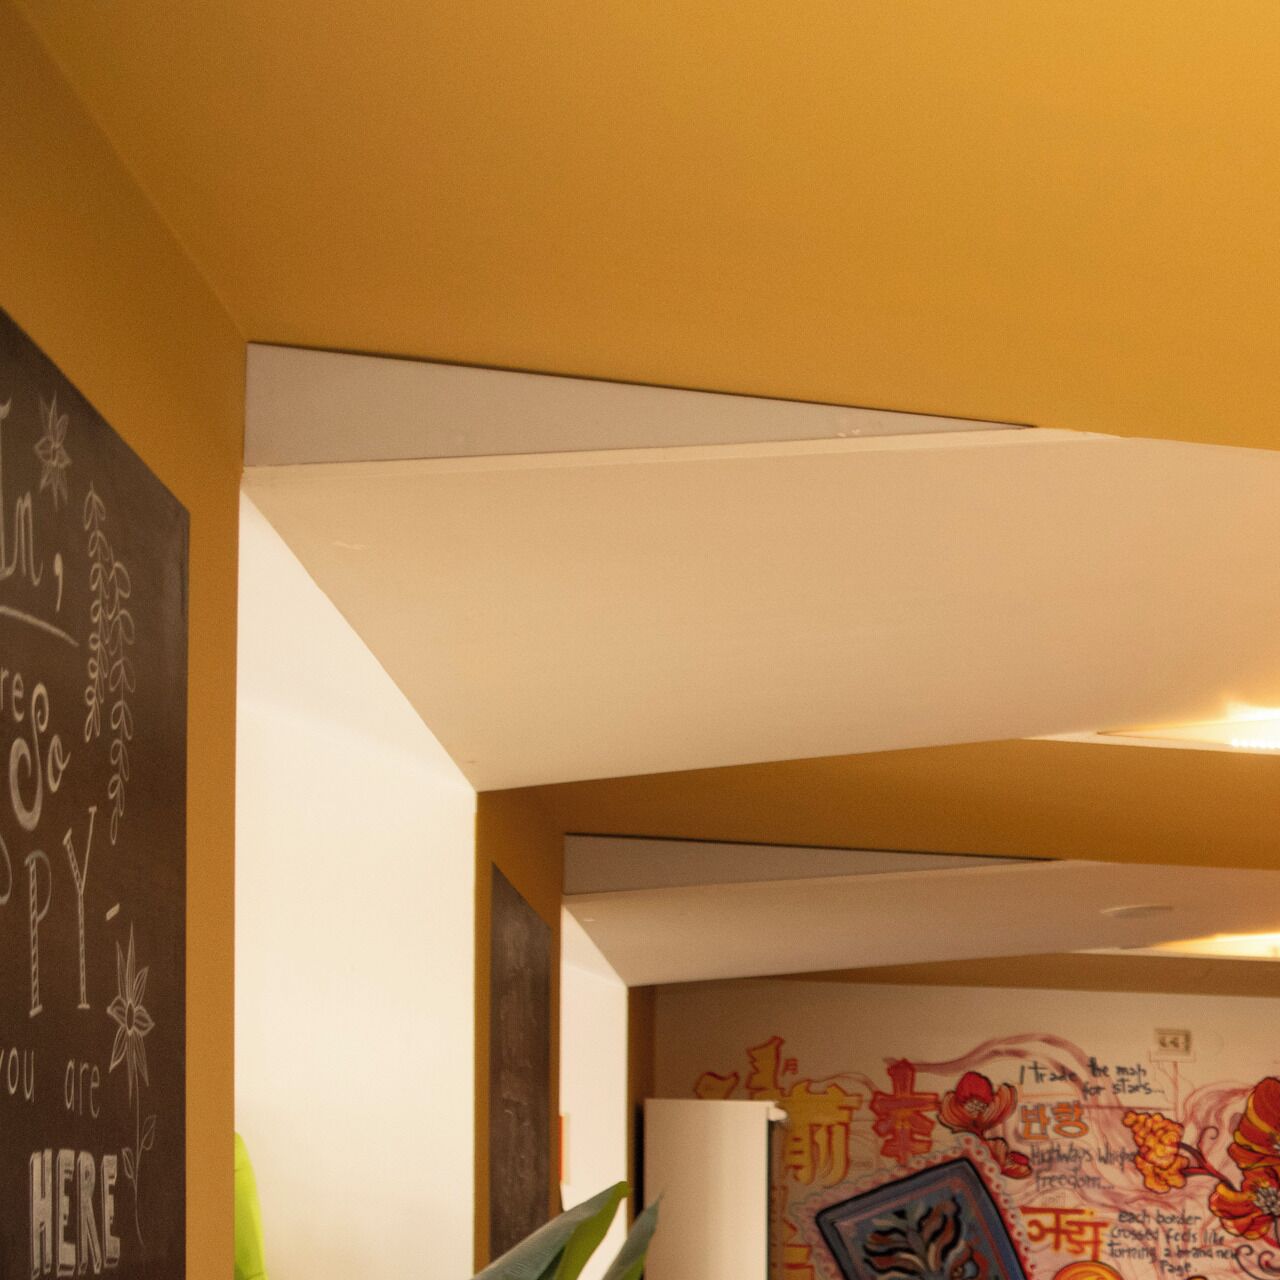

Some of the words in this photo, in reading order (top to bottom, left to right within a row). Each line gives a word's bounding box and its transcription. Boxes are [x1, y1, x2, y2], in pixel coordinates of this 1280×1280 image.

[9, 683, 71, 831] So
[65, 1058, 100, 1118] are
[1083, 1081, 1106, 1102] for
[1088, 1056, 1111, 1078] the
[1116, 1064, 1147, 1086] map
[30, 1148, 121, 1280] HERE
[1119, 1208, 1150, 1224] each
